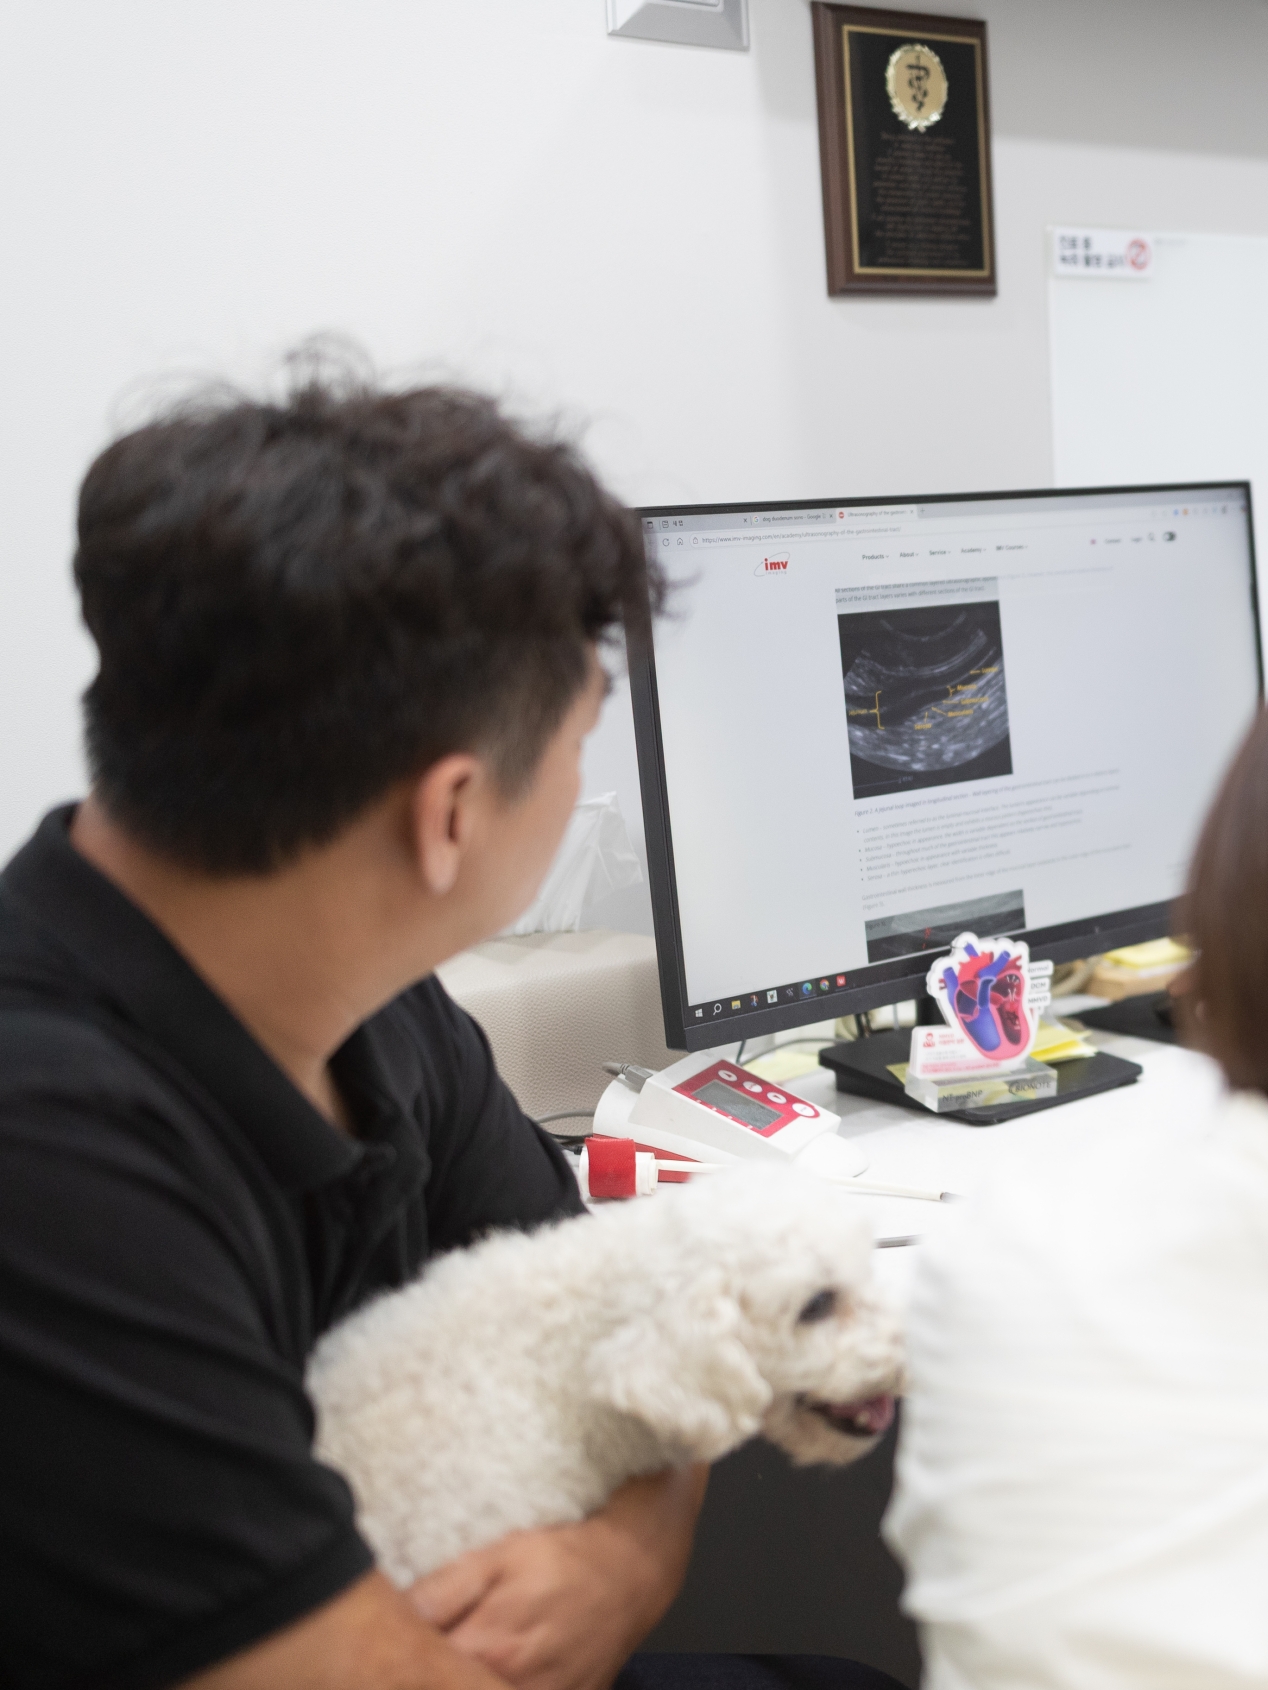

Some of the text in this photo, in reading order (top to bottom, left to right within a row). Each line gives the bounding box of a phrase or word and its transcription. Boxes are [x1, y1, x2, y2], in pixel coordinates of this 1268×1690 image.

[862, 553, 885, 561] Products
[960, 546, 982, 555] Academy
[764, 557, 789, 571] imv
[835, 596, 847, 605] parts
[917, 588, 936, 596] different
[854, 809, 868, 817] Figure
[877, 804, 893, 814] jejunal
[905, 799, 921, 808] imaged
[926, 794, 952, 805] longitudinal
[952, 792, 968, 800] section
[862, 826, 878, 834] Lumen
[882, 821, 907, 830] sometimes
[907, 817, 926, 826] referred
[890, 831, 898, 839] this
[899, 829, 913, 837] image
[921, 825, 935, 833] lumen
[940, 822, 954, 830] empty
[954, 819, 963, 827] and
[864, 845, 882, 853] Mucosa
[886, 839, 911, 850] hypoechoic
[952, 829, 964, 837] width
[969, 825, 985, 834] variable
[865, 853, 891, 862] Submucosa
[895, 846, 920, 857] throughout
[920, 844, 933, 852] much
[947, 835, 979, 848] gastrointestinal
[866, 862, 890, 872] Muscularis
[894, 856, 919, 867] hypoechoic
[925, 851, 950, 861] appearance
[961, 845, 977, 854] variable
[867, 873, 882, 881] Serosa
[900, 865, 926, 876] hyperechoic
[950, 855, 978, 866] identification
[861, 888, 897, 901] Gastrointestinal
[897, 886, 906, 894] wall
[906, 883, 927, 892] thickness
[932, 877, 954, 887] measured
[973, 871, 984, 879] inner
[1030, 982, 1047, 990] DCM
[941, 1089, 983, 1103] NT-proBNP
[1014, 1081, 1052, 1093] BIONOTE
